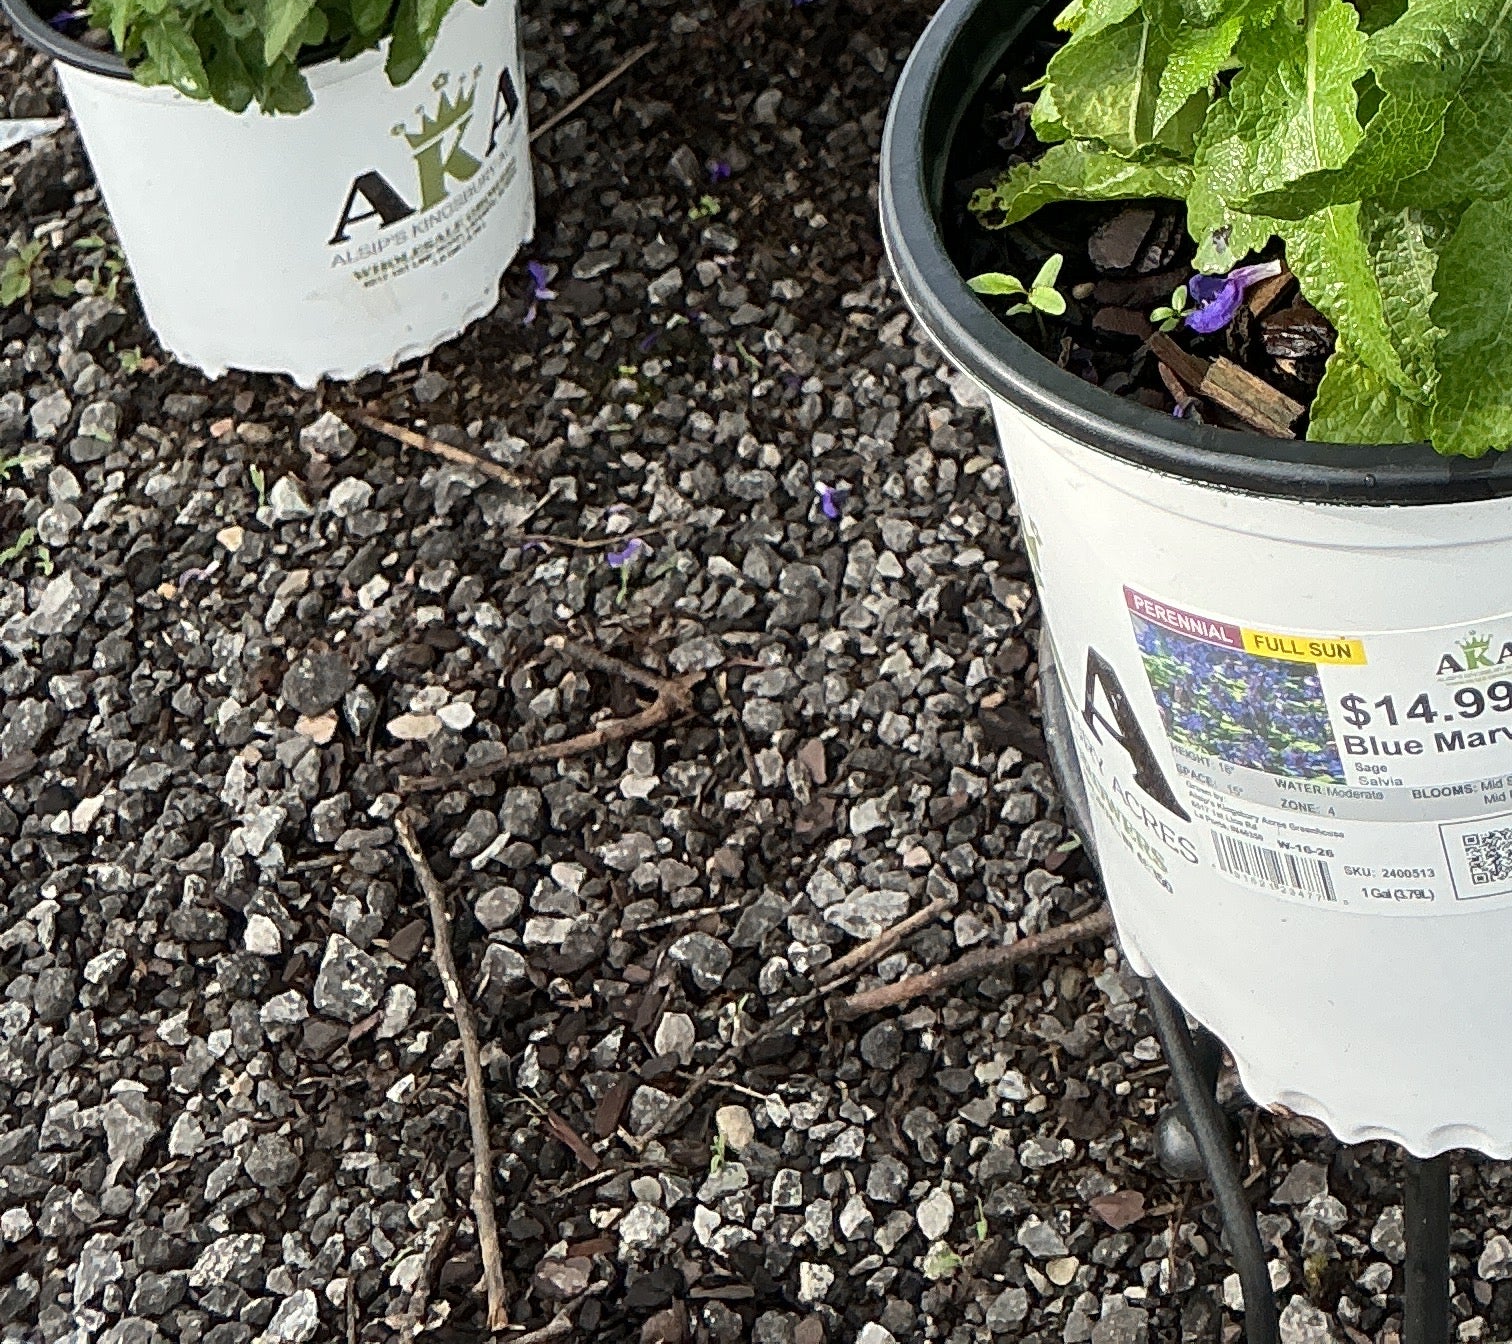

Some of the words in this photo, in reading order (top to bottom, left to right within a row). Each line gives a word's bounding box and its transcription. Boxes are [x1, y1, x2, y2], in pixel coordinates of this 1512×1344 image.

[328, 66, 519, 245] AKA
[1133, 593, 1234, 644] PERENNIAL
[1254, 634, 1304, 656] FULL
[1309, 642, 1352, 658] SUN
[1343, 734, 1424, 756] Blue
[1354, 762, 1388, 774] Sage
[1359, 775, 1404, 787] Salvia
[1412, 784, 1478, 799] BLOOMS:
[1481, 778, 1504, 792] Mid
[1327, 786, 1384, 800] Moderate
[1484, 793, 1507, 805] Mid
[1111, 775, 1199, 864] ACRES
[1343, 865, 1377, 879] SKU:
[1382, 868, 1436, 879] 2400513
